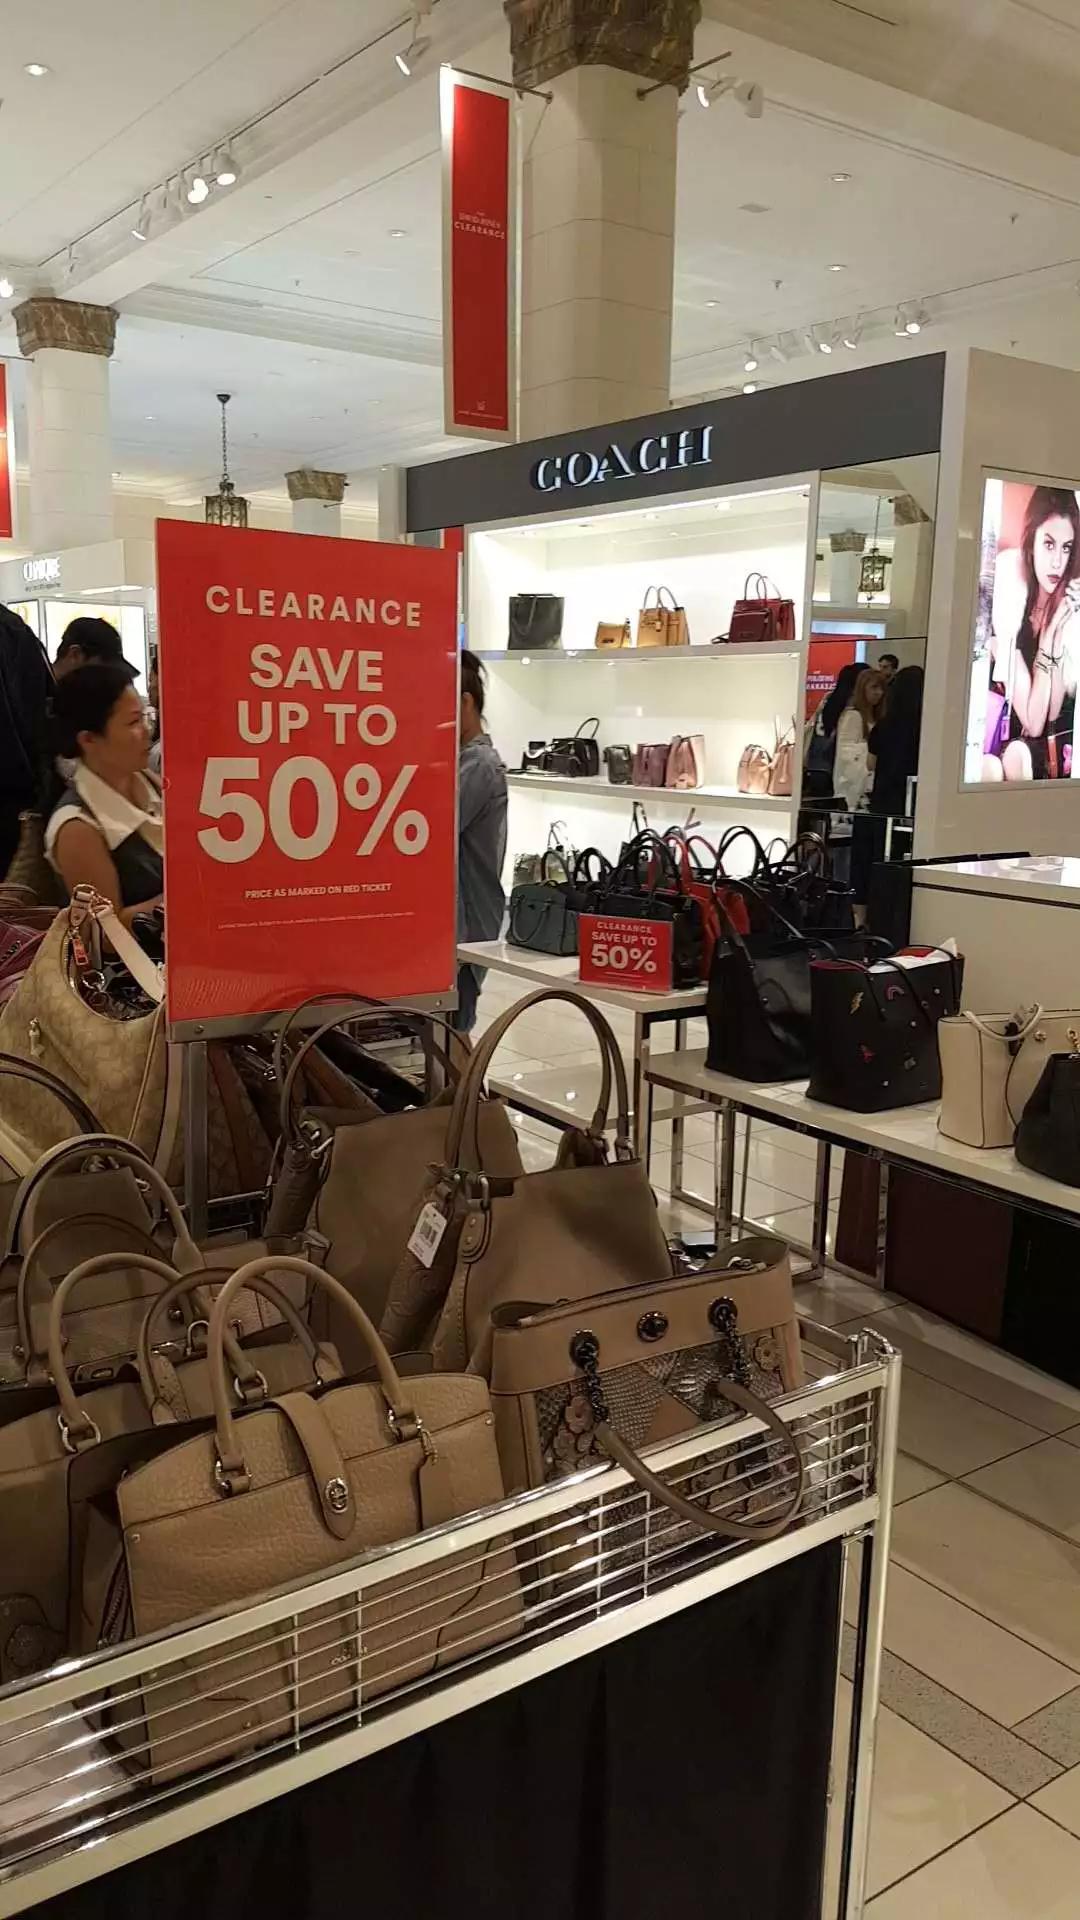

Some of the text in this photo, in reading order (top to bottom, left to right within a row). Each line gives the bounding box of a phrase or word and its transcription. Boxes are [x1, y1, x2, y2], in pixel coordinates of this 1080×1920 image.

[535, 425, 713, 492] COACH
[206, 585, 421, 627] CLEARANCE
[250, 644, 383, 692] SAVE
[238, 700, 397, 746] UP TO
[197, 755, 430, 864] 50%
[245, 882, 392, 898] PRICE AS MARKED ON RED TICKET
[591, 931, 657, 946] SAVE UP TO
[597, 921, 652, 934] CLEARANCE
[591, 943, 657, 973] 50%
